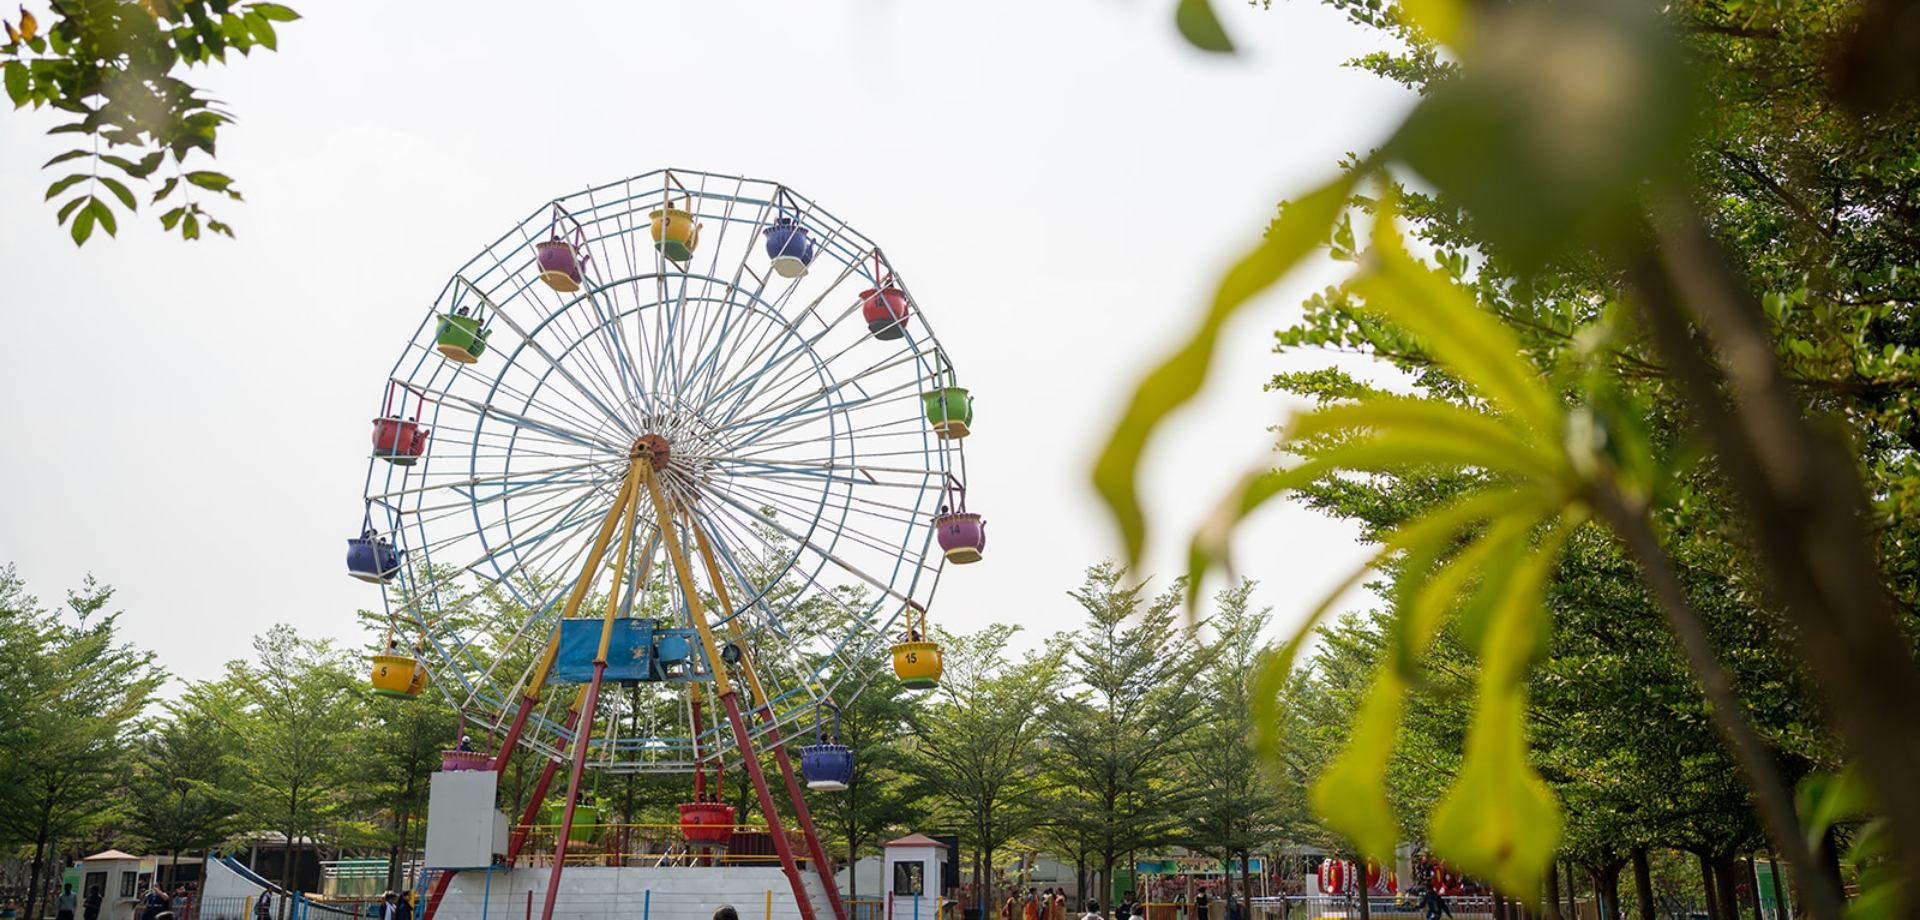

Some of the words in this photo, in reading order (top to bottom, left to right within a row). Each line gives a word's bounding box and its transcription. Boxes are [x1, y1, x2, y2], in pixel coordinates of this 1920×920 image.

[660, 217, 670, 227] 0
[776, 235, 785, 244] 11
[547, 250, 553, 260] 9
[874, 298, 884, 307] 12
[381, 427, 388, 437] 7
[949, 524, 961, 536] 14
[905, 652, 917, 664] 15
[381, 666, 387, 677] 5
[1176, 860, 1200, 873] Spiral
[1203, 860, 1218, 872] Jet
